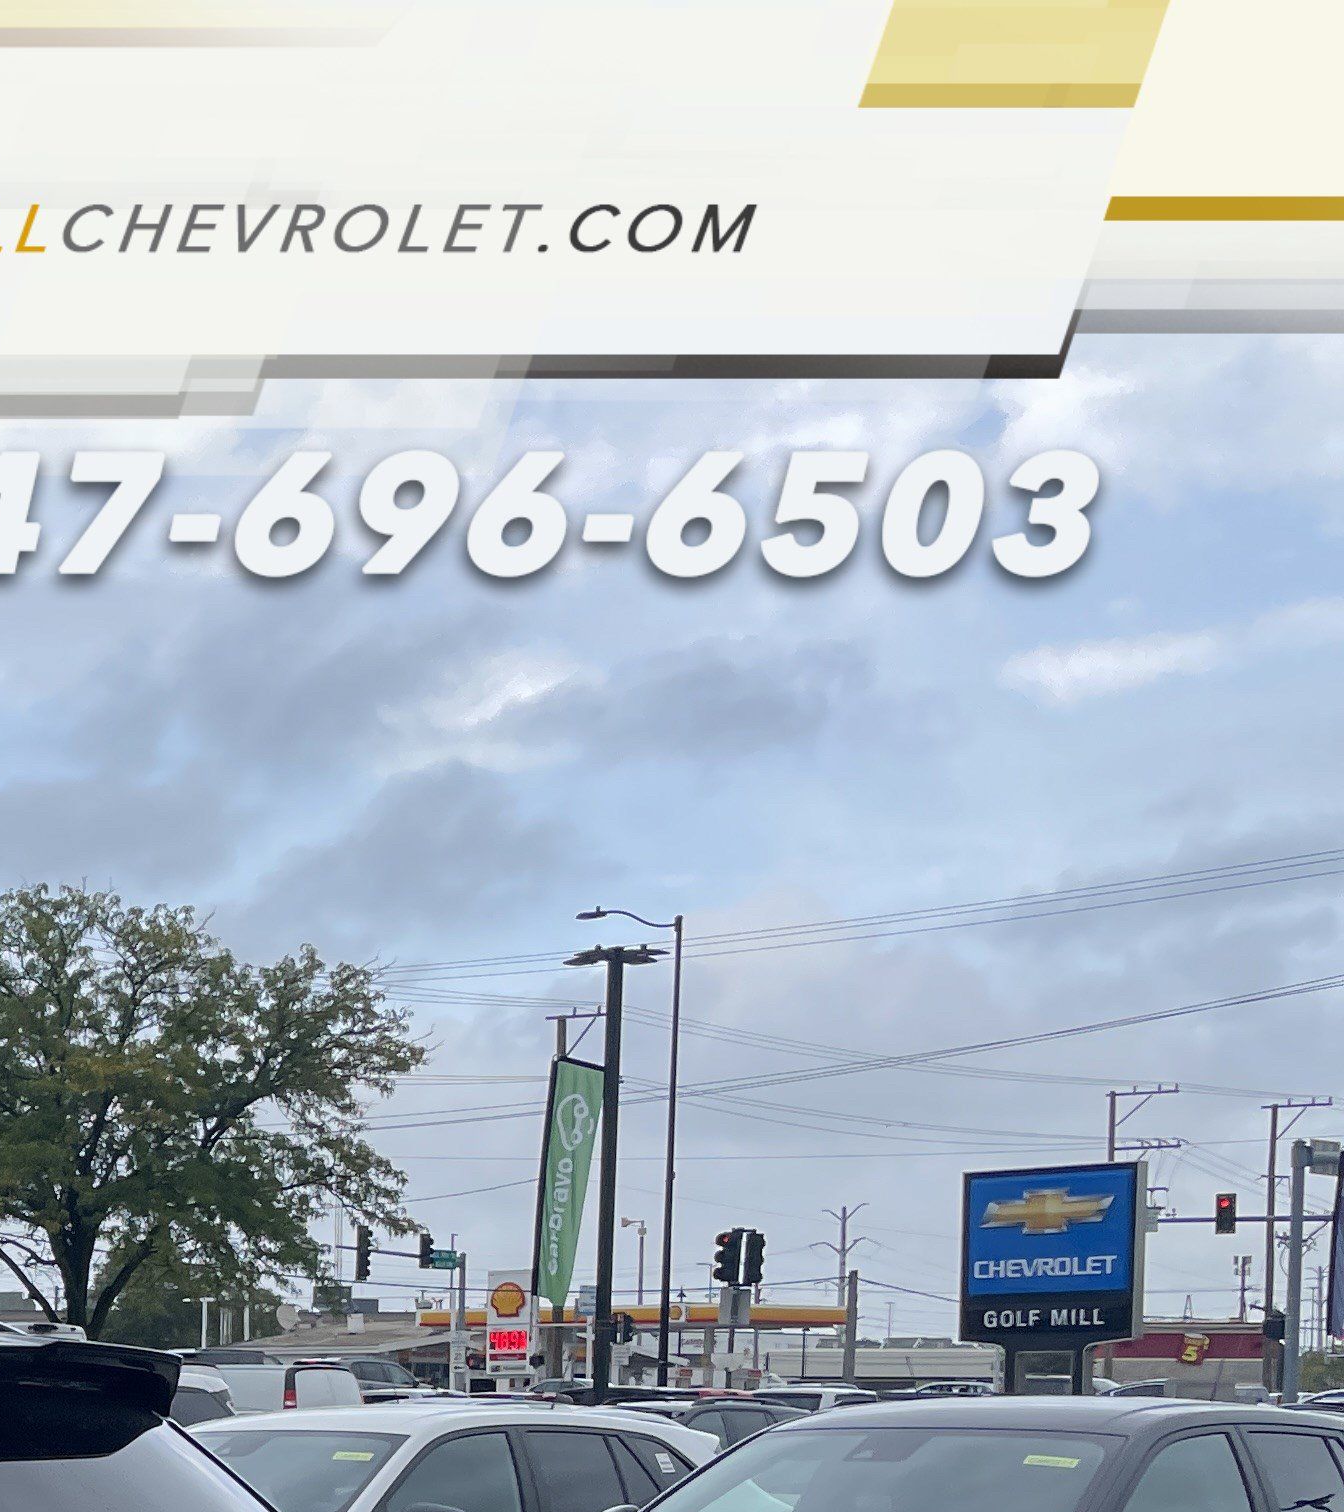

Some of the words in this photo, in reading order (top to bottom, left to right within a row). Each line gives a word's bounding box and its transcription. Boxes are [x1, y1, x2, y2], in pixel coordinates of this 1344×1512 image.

[973, 1255, 1118, 1279] CHEVROLET
[983, 1310, 1041, 1328] GOLF
[1050, 1308, 1105, 1326] MILL
